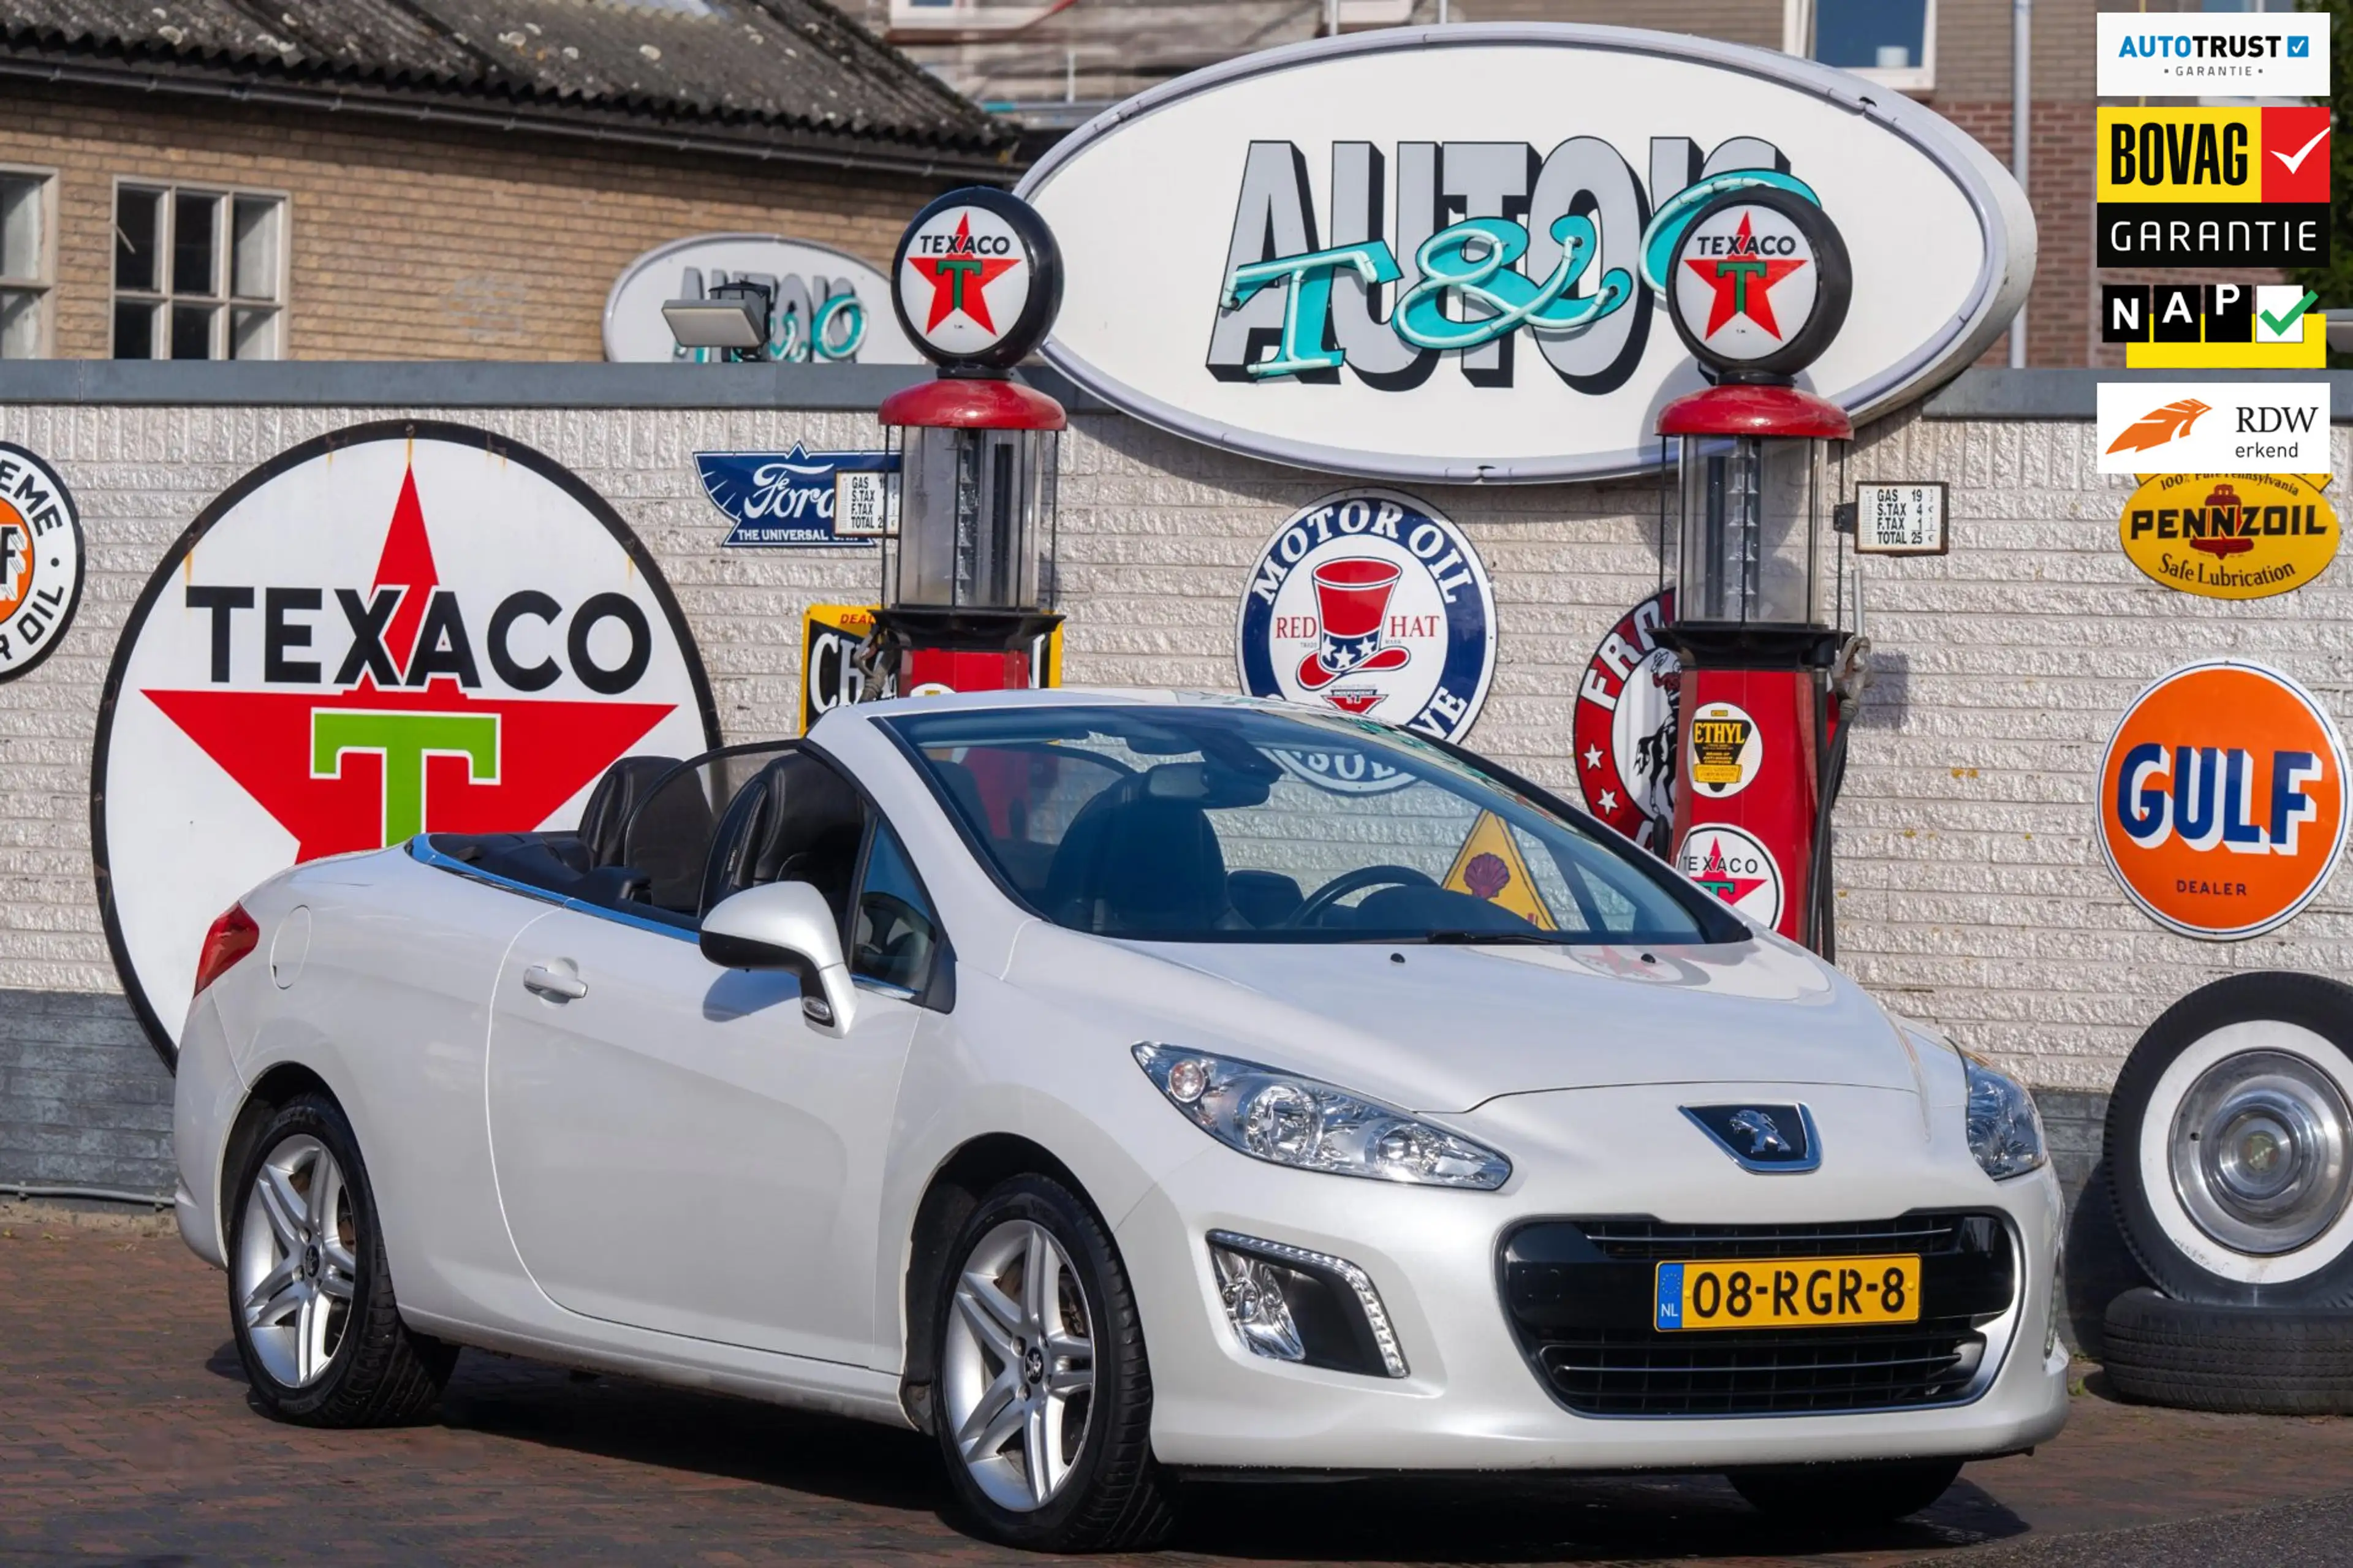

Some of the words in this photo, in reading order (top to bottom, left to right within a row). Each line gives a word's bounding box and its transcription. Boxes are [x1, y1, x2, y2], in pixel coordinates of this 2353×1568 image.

[920, 235, 1010, 255] TEXACO
[1697, 235, 1796, 256] TEXACO
[936, 260, 982, 308] T
[1717, 261, 1767, 312] T
[852, 477, 868, 489] GAS
[851, 490, 875, 502] S.TAX
[1877, 489, 1898, 502] GAS
[1911, 489, 1922, 502] 19
[851, 503, 874, 515] F.TAX
[1877, 503, 1906, 516] S.TAX
[1917, 503, 1923, 516] 4
[851, 516, 874, 529] TOTAL
[1877, 517, 1905, 530] F.TAX
[1917, 518, 1922, 531] 1
[2131, 505, 2327, 540] PENNZOIL
[737, 529, 759, 540] THE
[762, 529, 829, 541] UNIVERSAL
[1877, 531, 1907, 544] TOTAL
[1911, 531, 1923, 544] 25
[1252, 499, 1403, 605] MOTOR
[1409, 525, 1472, 604] OIL
[2158, 553, 2194, 581] Safe
[2198, 562, 2295, 586] Lubrication
[17, 585, 64, 645] OIL
[1276, 616, 1317, 638] RED
[1390, 616, 1440, 638] HAT
[186, 585, 652, 695] TEXACO
[1694, 722, 1746, 744] ETHYL
[311, 708, 501, 847] T
[2117, 743, 2322, 855] GULF
[2176, 879, 2248, 896] DEALER
[1692, 1267, 1906, 1319] 08-RGR-8
[1661, 1303, 1678, 1317] NL
